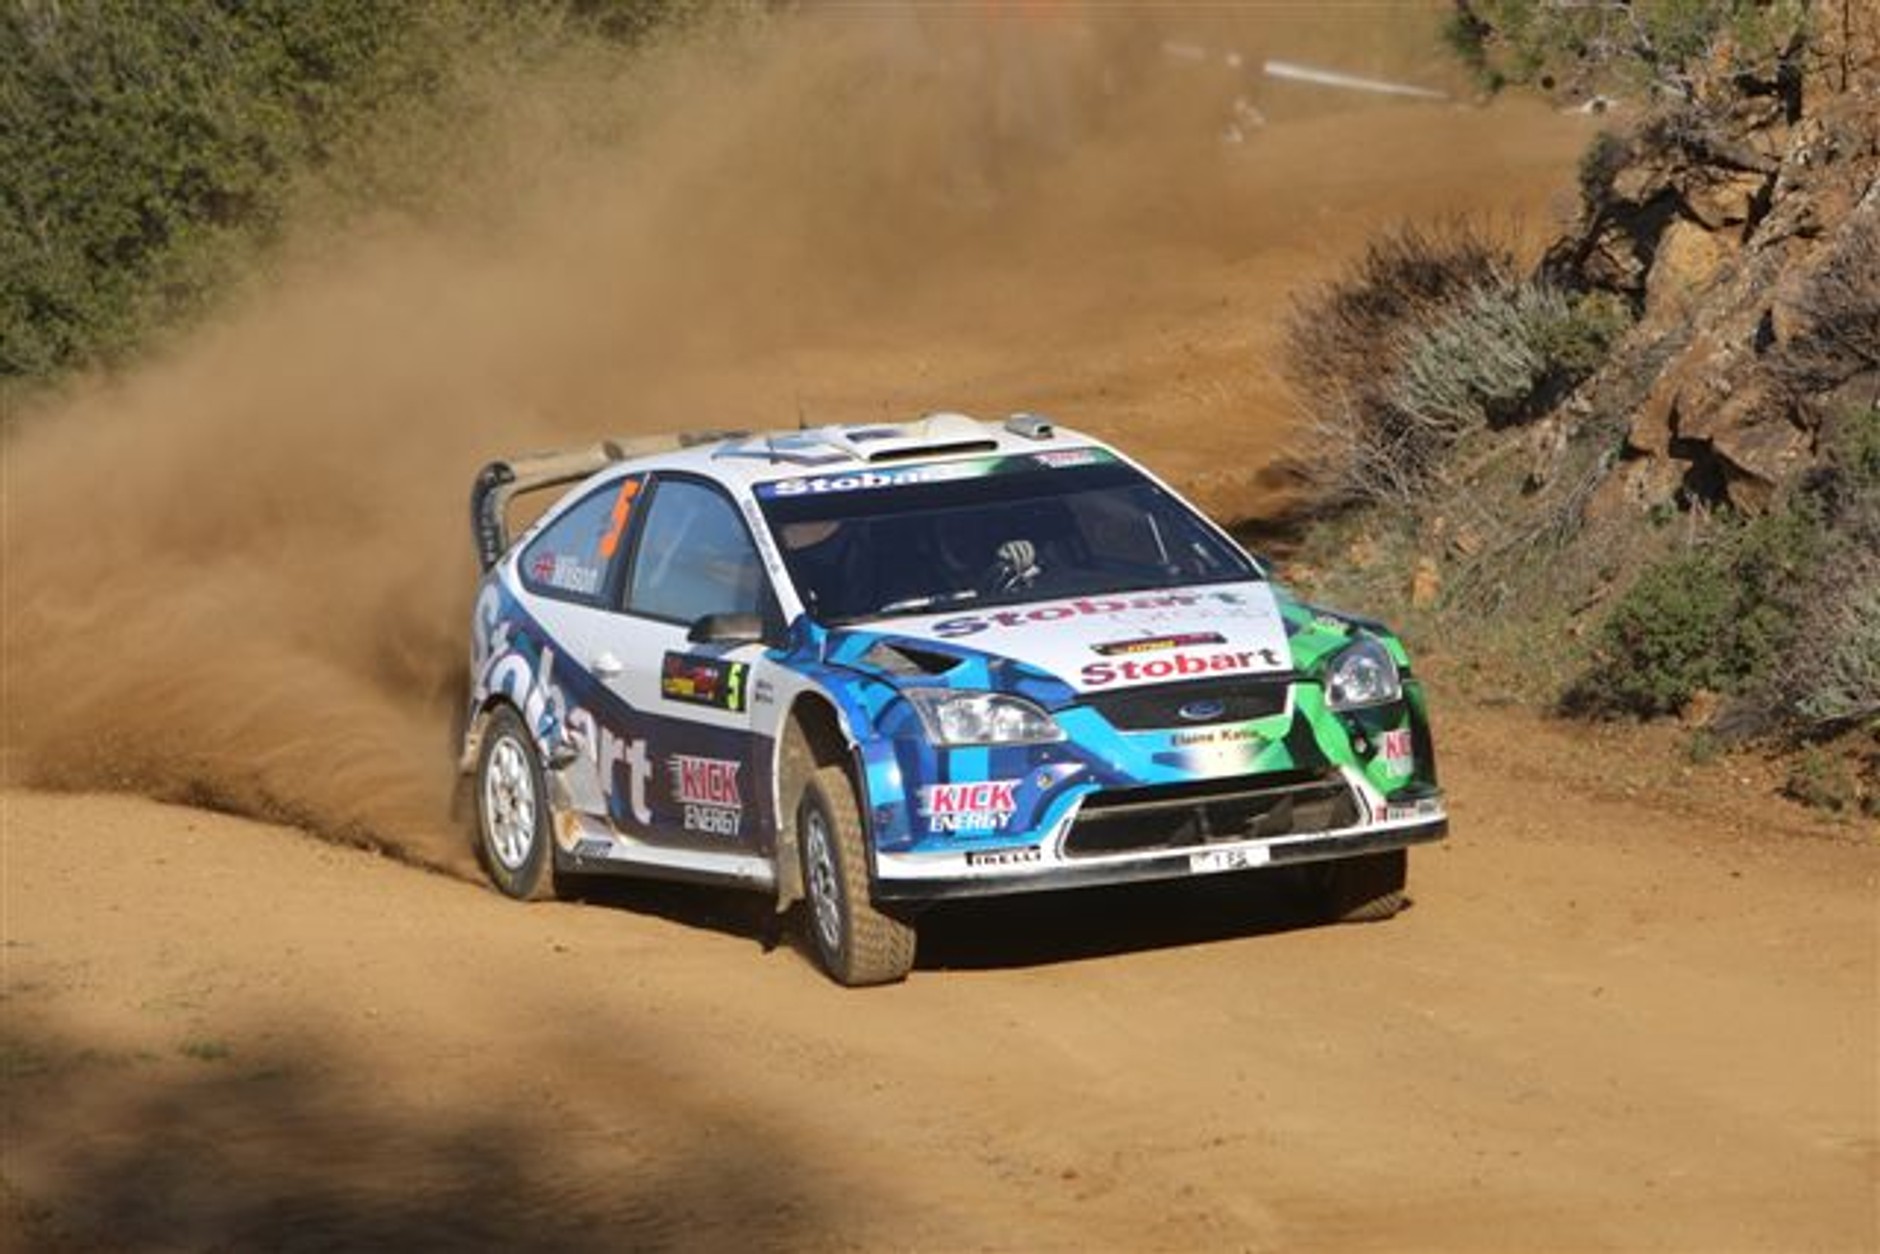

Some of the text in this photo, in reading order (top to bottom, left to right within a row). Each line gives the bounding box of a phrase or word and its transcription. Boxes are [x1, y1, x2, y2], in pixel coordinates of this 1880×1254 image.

[600, 480, 641, 559] 5
[1081, 648, 1282, 685] Stobart
[727, 661, 742, 710] 5
[681, 759, 739, 804] KICK
[932, 782, 1013, 813] KICK
[684, 804, 740, 835] ENERGY
[930, 812, 1011, 832] ENERGY
